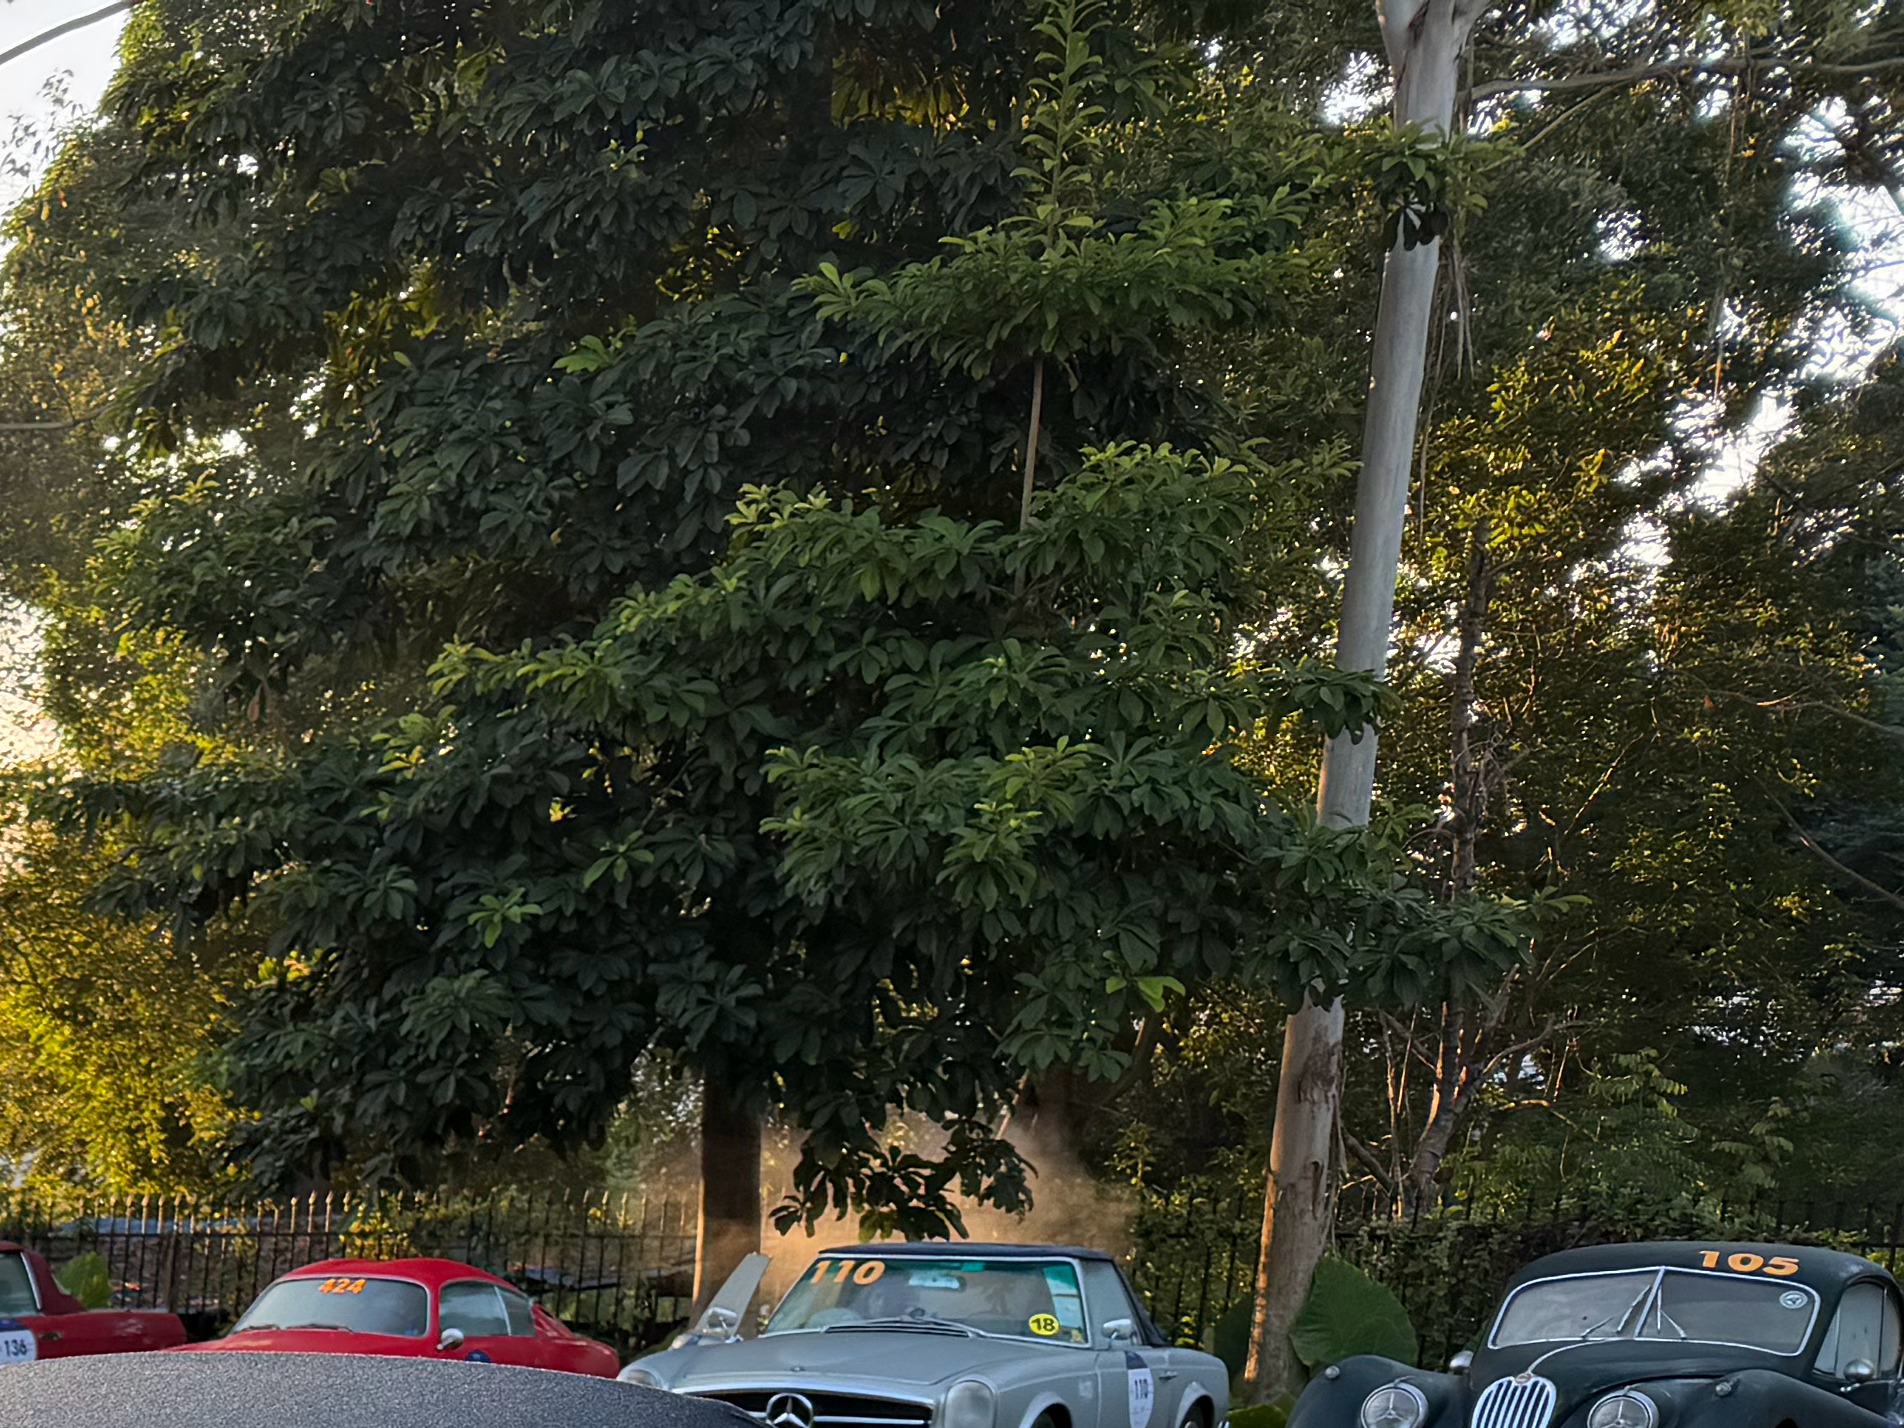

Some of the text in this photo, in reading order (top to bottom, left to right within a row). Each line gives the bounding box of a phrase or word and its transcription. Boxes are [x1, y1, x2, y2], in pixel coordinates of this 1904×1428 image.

[810, 1260, 886, 1285] 110
[1698, 1250, 1800, 1276] 105
[319, 1278, 367, 1295] 424
[1031, 1317, 1056, 1333] 18
